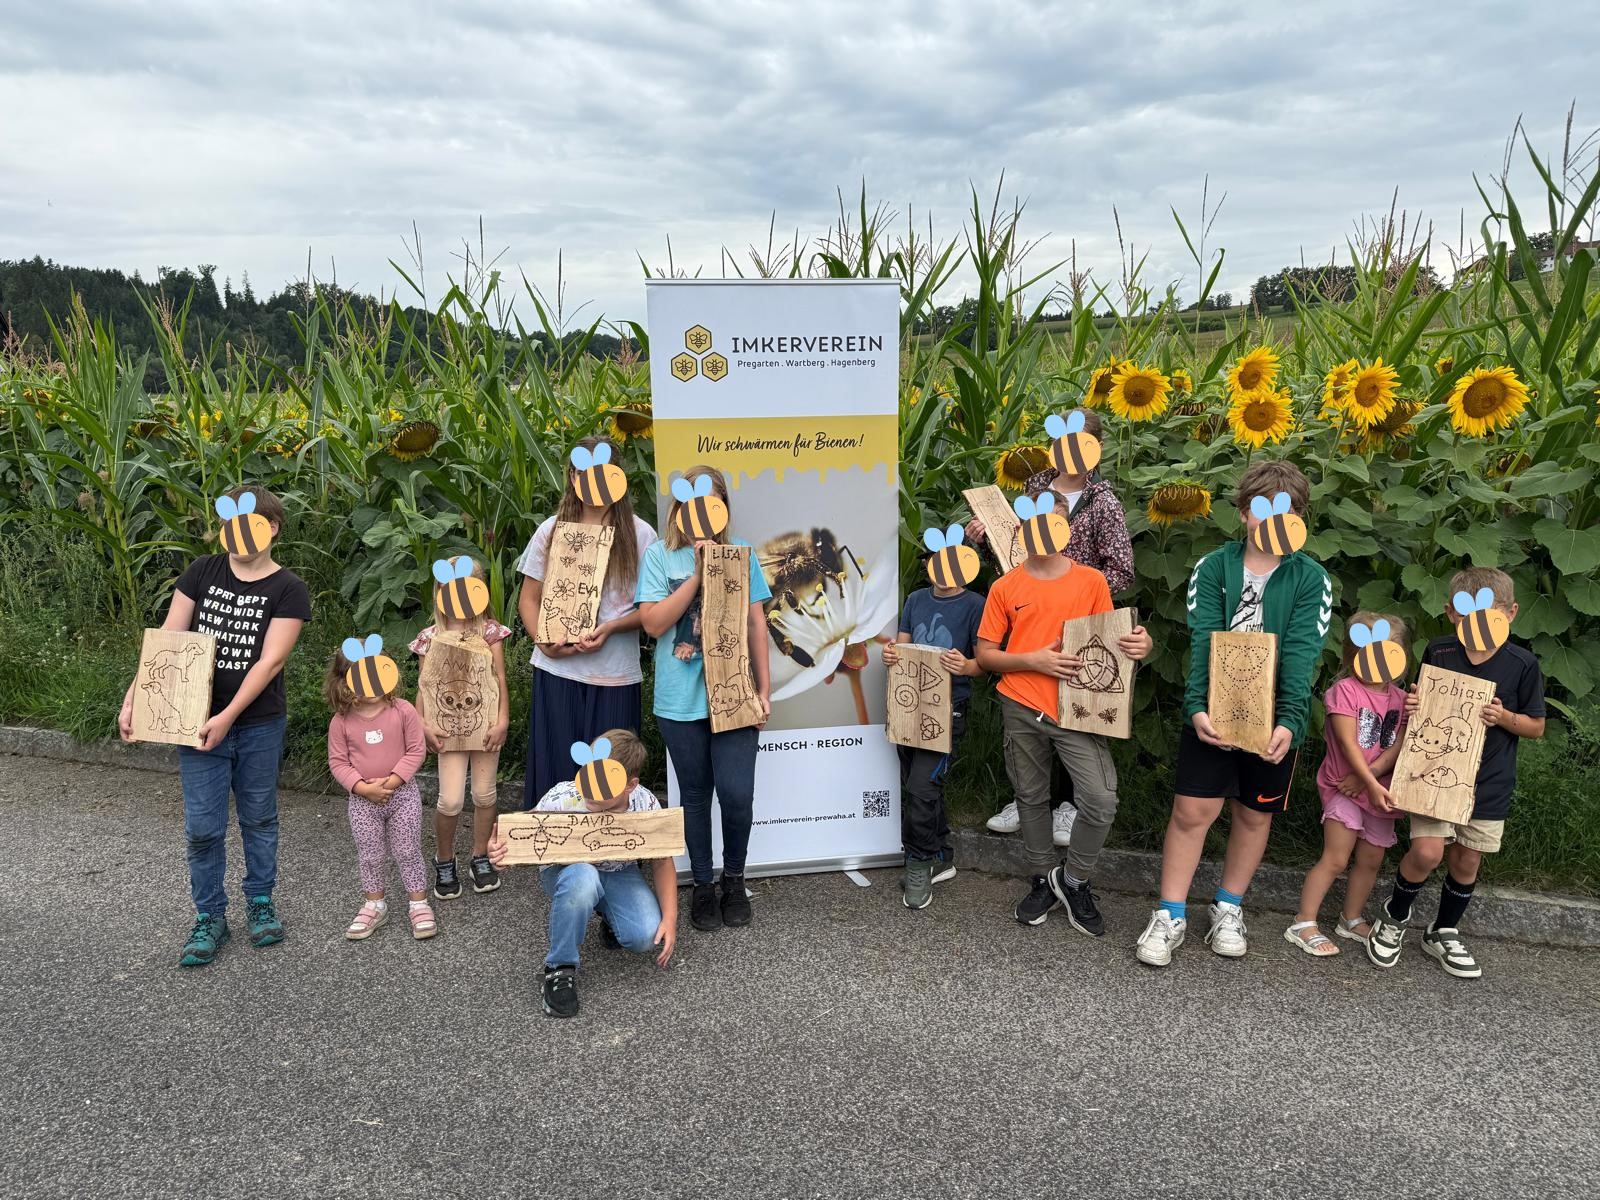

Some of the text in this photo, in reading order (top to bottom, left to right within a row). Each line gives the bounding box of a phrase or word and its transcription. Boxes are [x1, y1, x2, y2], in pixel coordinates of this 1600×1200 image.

[731, 335, 883, 354] IMKERVEREIN
[737, 357, 877, 369] Pregarten Wartberg Hagenberg
[697, 430, 865, 458] Wir schwärmen für Bienen!
[712, 546, 741, 561] LISA
[207, 585, 268, 606] SPRT DEPT
[578, 582, 598, 599] EVA
[202, 598, 264, 619] WRLDWIDE
[199, 611, 260, 632] NEW YORK
[197, 623, 256, 645] MANHATTAN
[217, 645, 252, 658] OWN
[215, 658, 249, 671] OAST
[1426, 675, 1486, 701] Tobias
[757, 737, 863, 752] MENSCH REGION
[567, 814, 615, 828] DAVID
